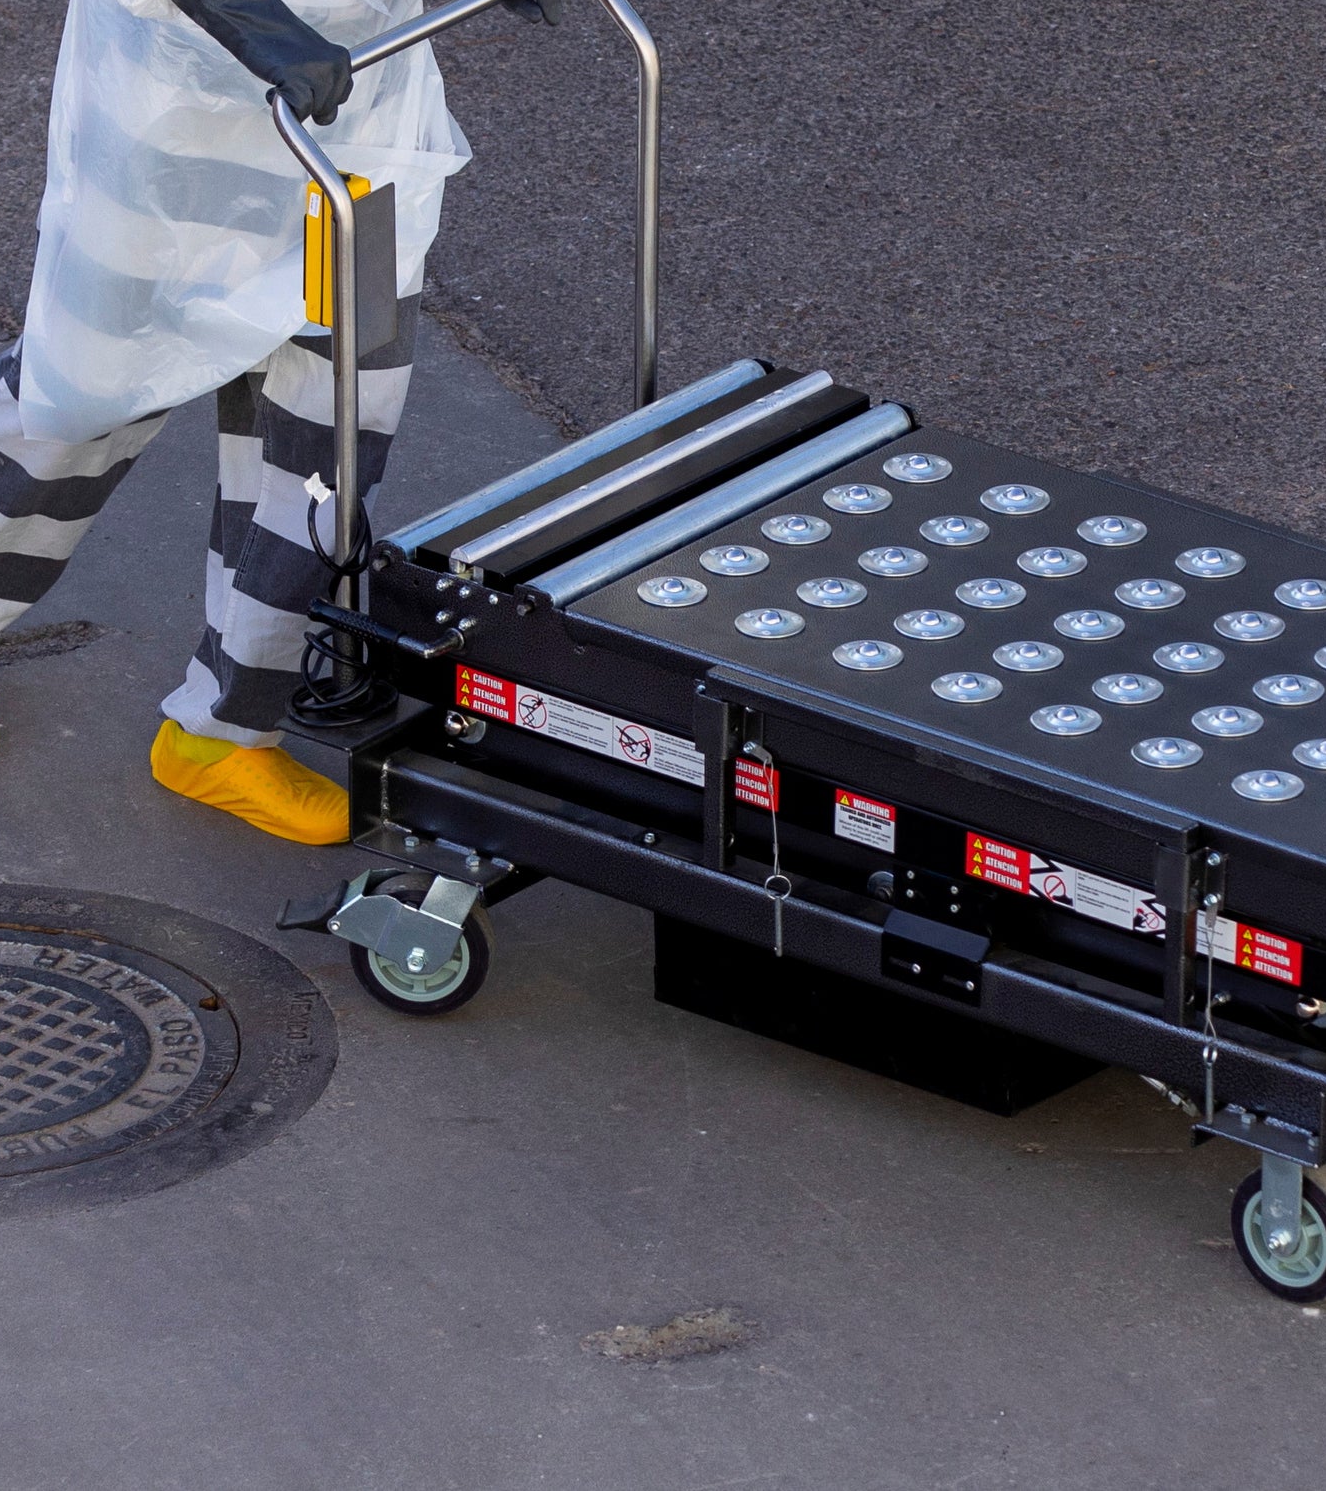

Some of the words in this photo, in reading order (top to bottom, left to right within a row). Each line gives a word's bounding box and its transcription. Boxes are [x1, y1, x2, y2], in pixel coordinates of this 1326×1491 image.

[473, 673, 503, 691] CAUTION
[472, 700, 509, 720] ATTENTION
[853, 798, 890, 818] WARNING
[985, 842, 1017, 861] CAUTION
[985, 869, 1023, 890] ATTENTION
[1255, 932, 1287, 951] CAUTION
[33, 947, 172, 1009] WATER
[1254, 960, 1293, 981] ATTENTION
[157, 1017, 200, 1076] PASO
[124, 1083, 182, 1111] EL
